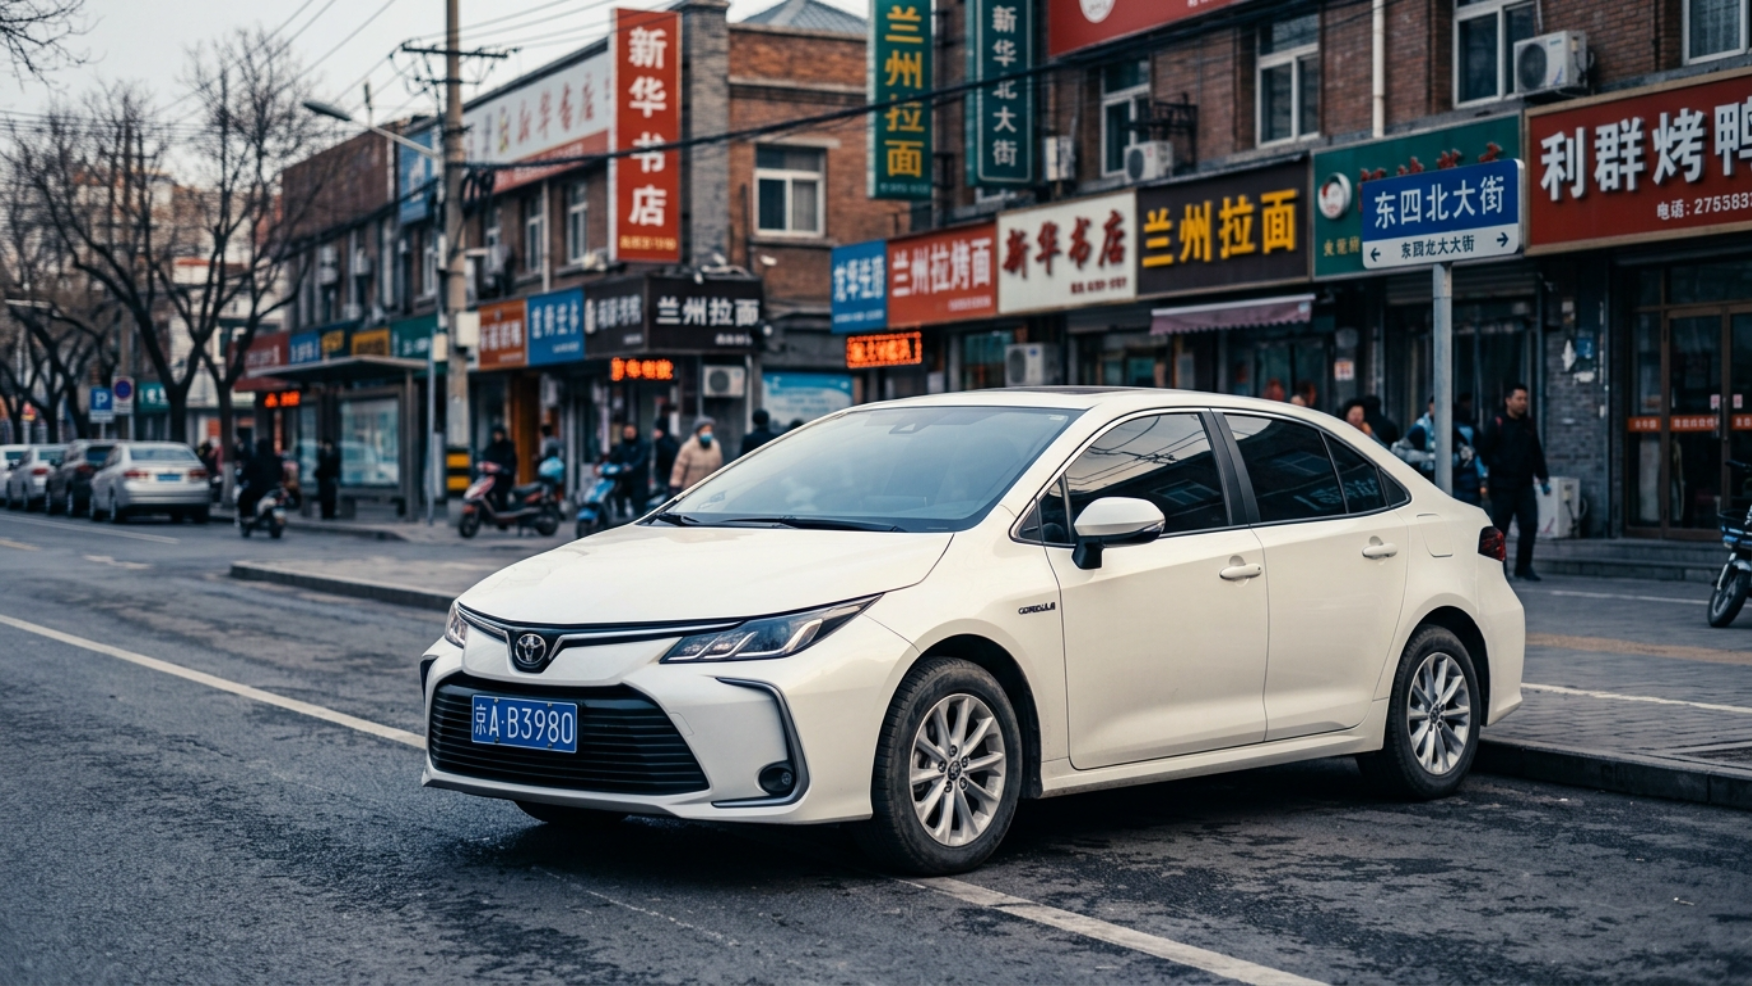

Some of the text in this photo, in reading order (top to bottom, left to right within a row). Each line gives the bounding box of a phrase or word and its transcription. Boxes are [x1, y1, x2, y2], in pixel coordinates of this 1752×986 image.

[885, 5, 925, 178] 兰州拉面
[992, 5, 1017, 167] 新华北大街
[628, 27, 667, 227] 新华书店
[1540, 96, 1752, 201] 利群烤鸭
[1142, 189, 1297, 268] 兰州拉面
[1374, 175, 1504, 229] 东四北大街
[1694, 193, 1752, 214] 275583
[1003, 209, 1126, 279] 新华书店
[656, 296, 759, 326] 兰州拉面
[475, 703, 573, 744] 京A·B3980
